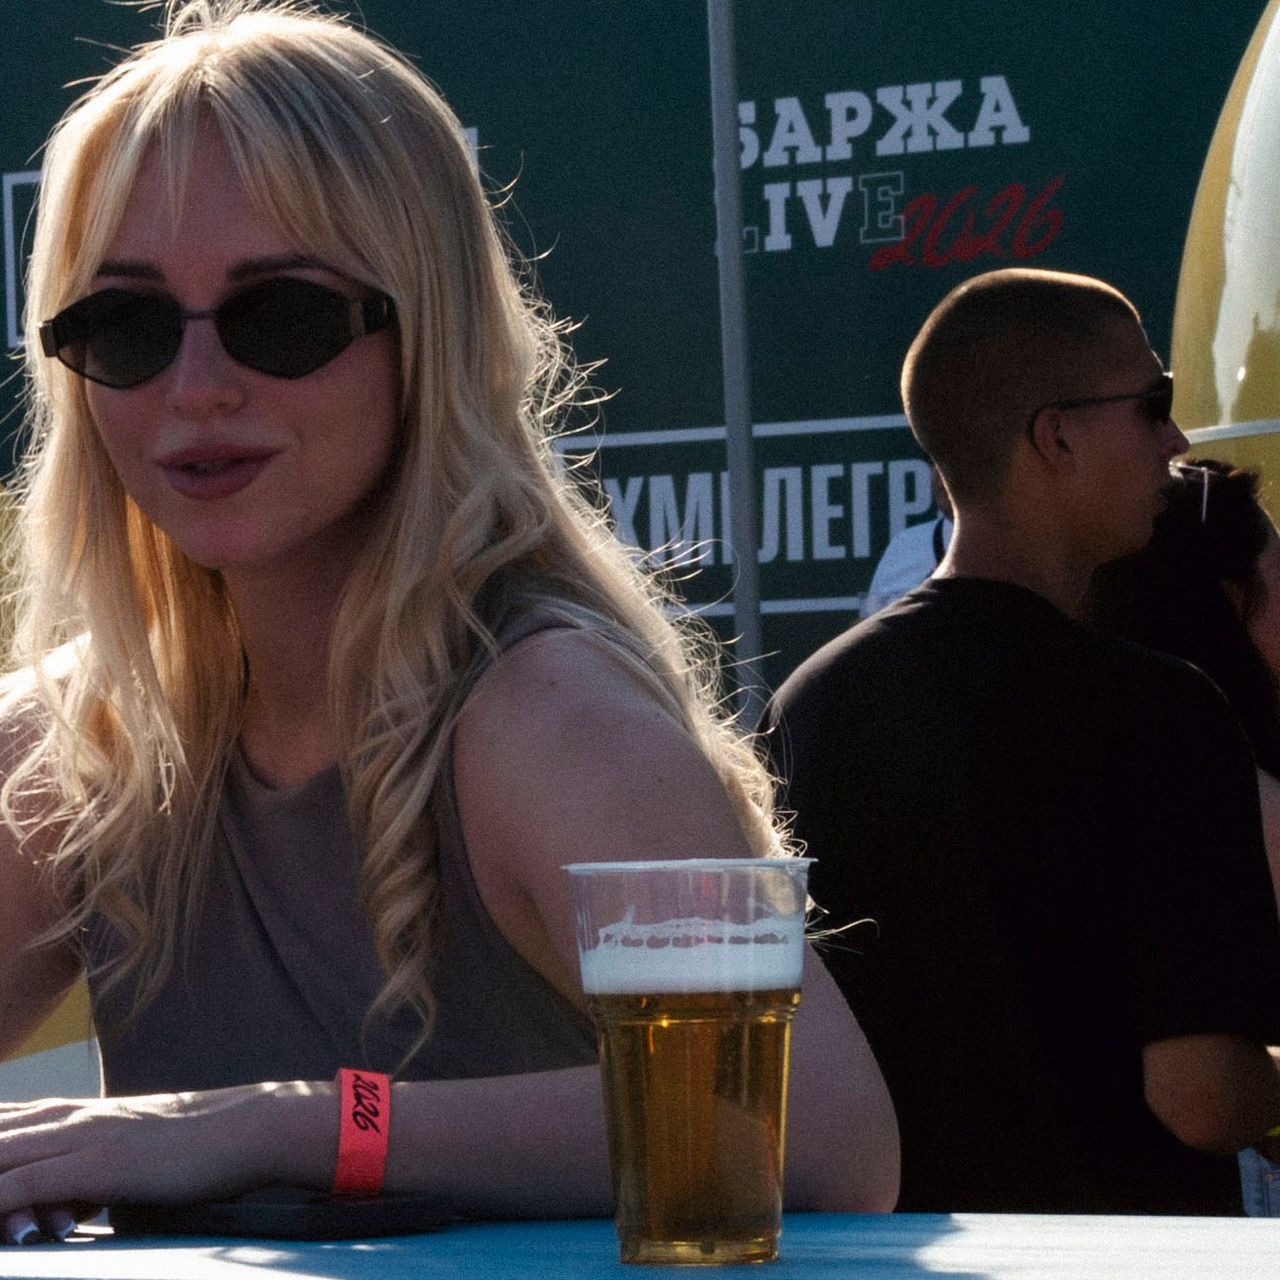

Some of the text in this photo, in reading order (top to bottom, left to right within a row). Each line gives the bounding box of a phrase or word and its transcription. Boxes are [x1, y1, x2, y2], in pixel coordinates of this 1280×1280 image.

[742, 171, 1065, 270] IVE 2026
[602, 458, 933, 567] ХМЛЕГР
[352, 1073, 381, 1135] 2026
